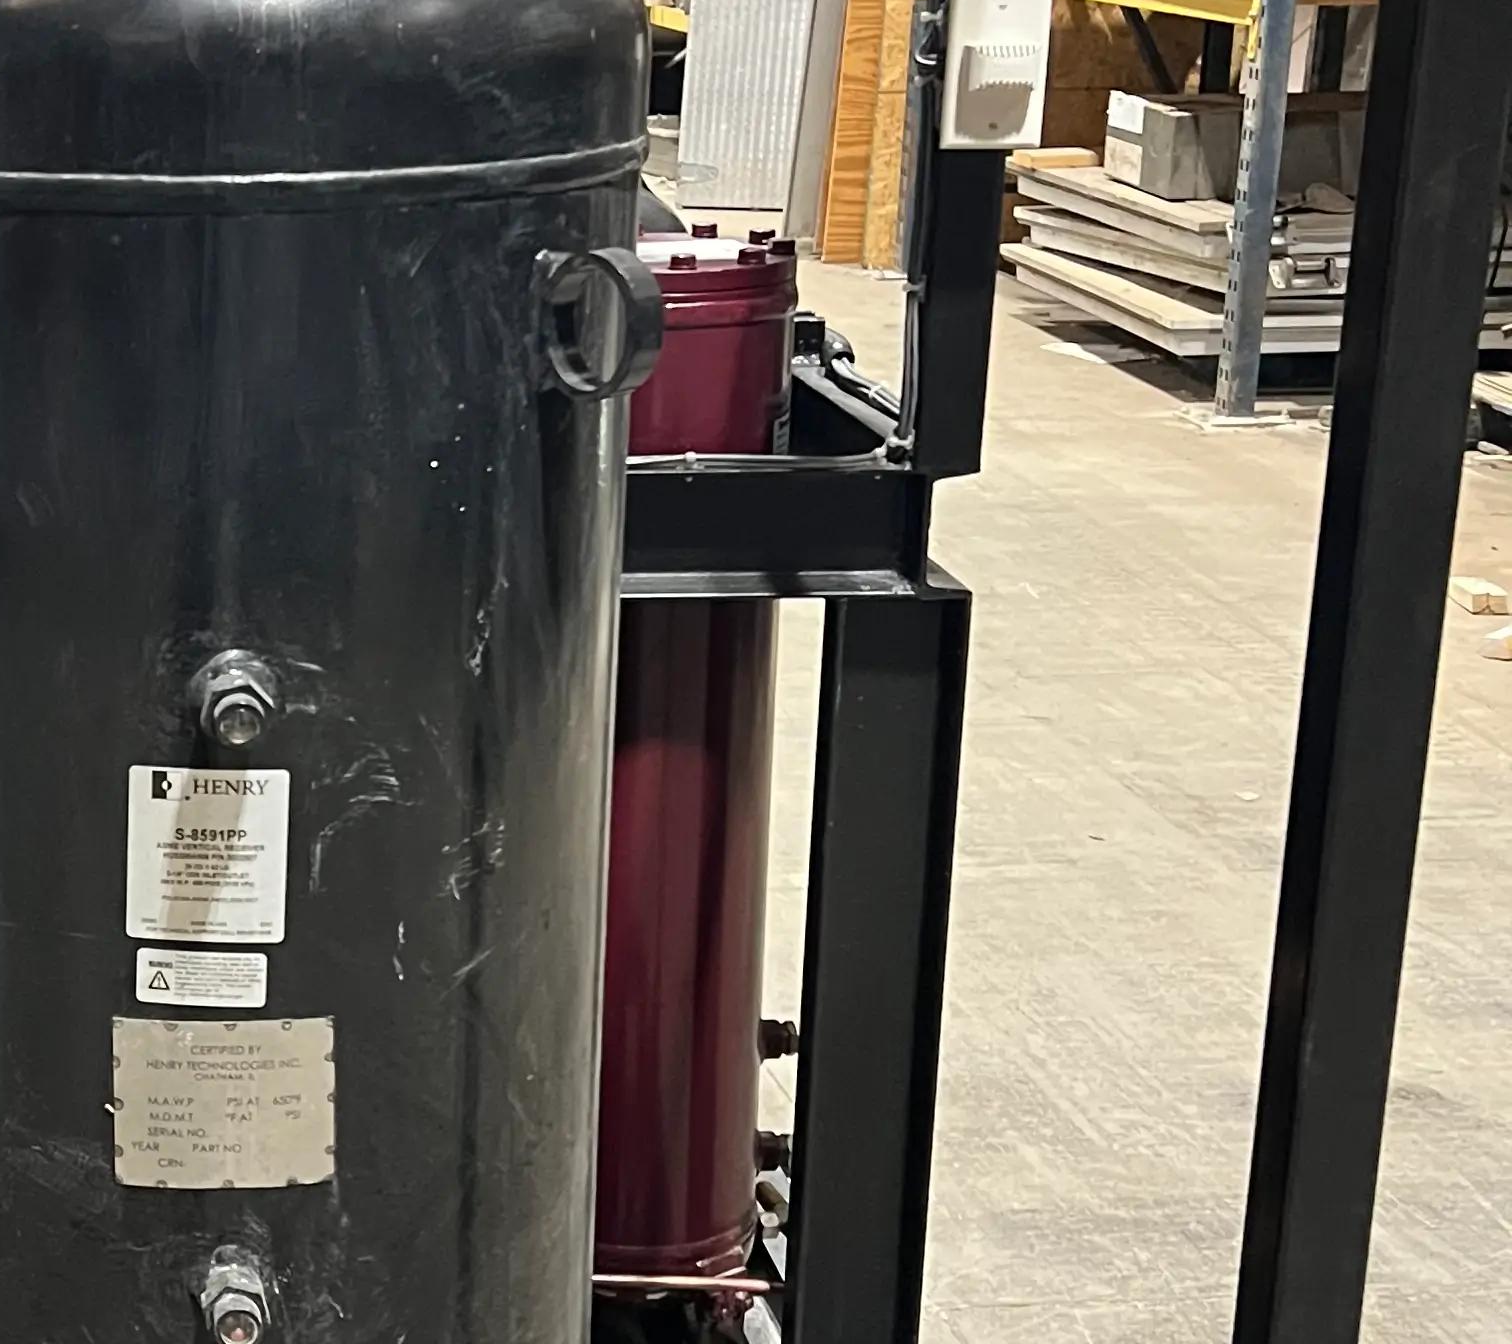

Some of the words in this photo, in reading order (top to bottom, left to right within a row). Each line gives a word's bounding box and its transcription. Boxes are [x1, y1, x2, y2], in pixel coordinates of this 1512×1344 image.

[192, 779, 270, 796] HENRY
[175, 828, 247, 842] S-8591PP
[190, 1045, 244, 1055] CERTIFIED
[248, 1045, 261, 1055] BY
[146, 1059, 183, 1070] HENRY
[186, 1059, 276, 1070] TECHNOLOGIES
[147, 1127, 183, 1138] SERIAL
[131, 1141, 160, 1152] YEAR
[192, 1143, 220, 1153] PART
